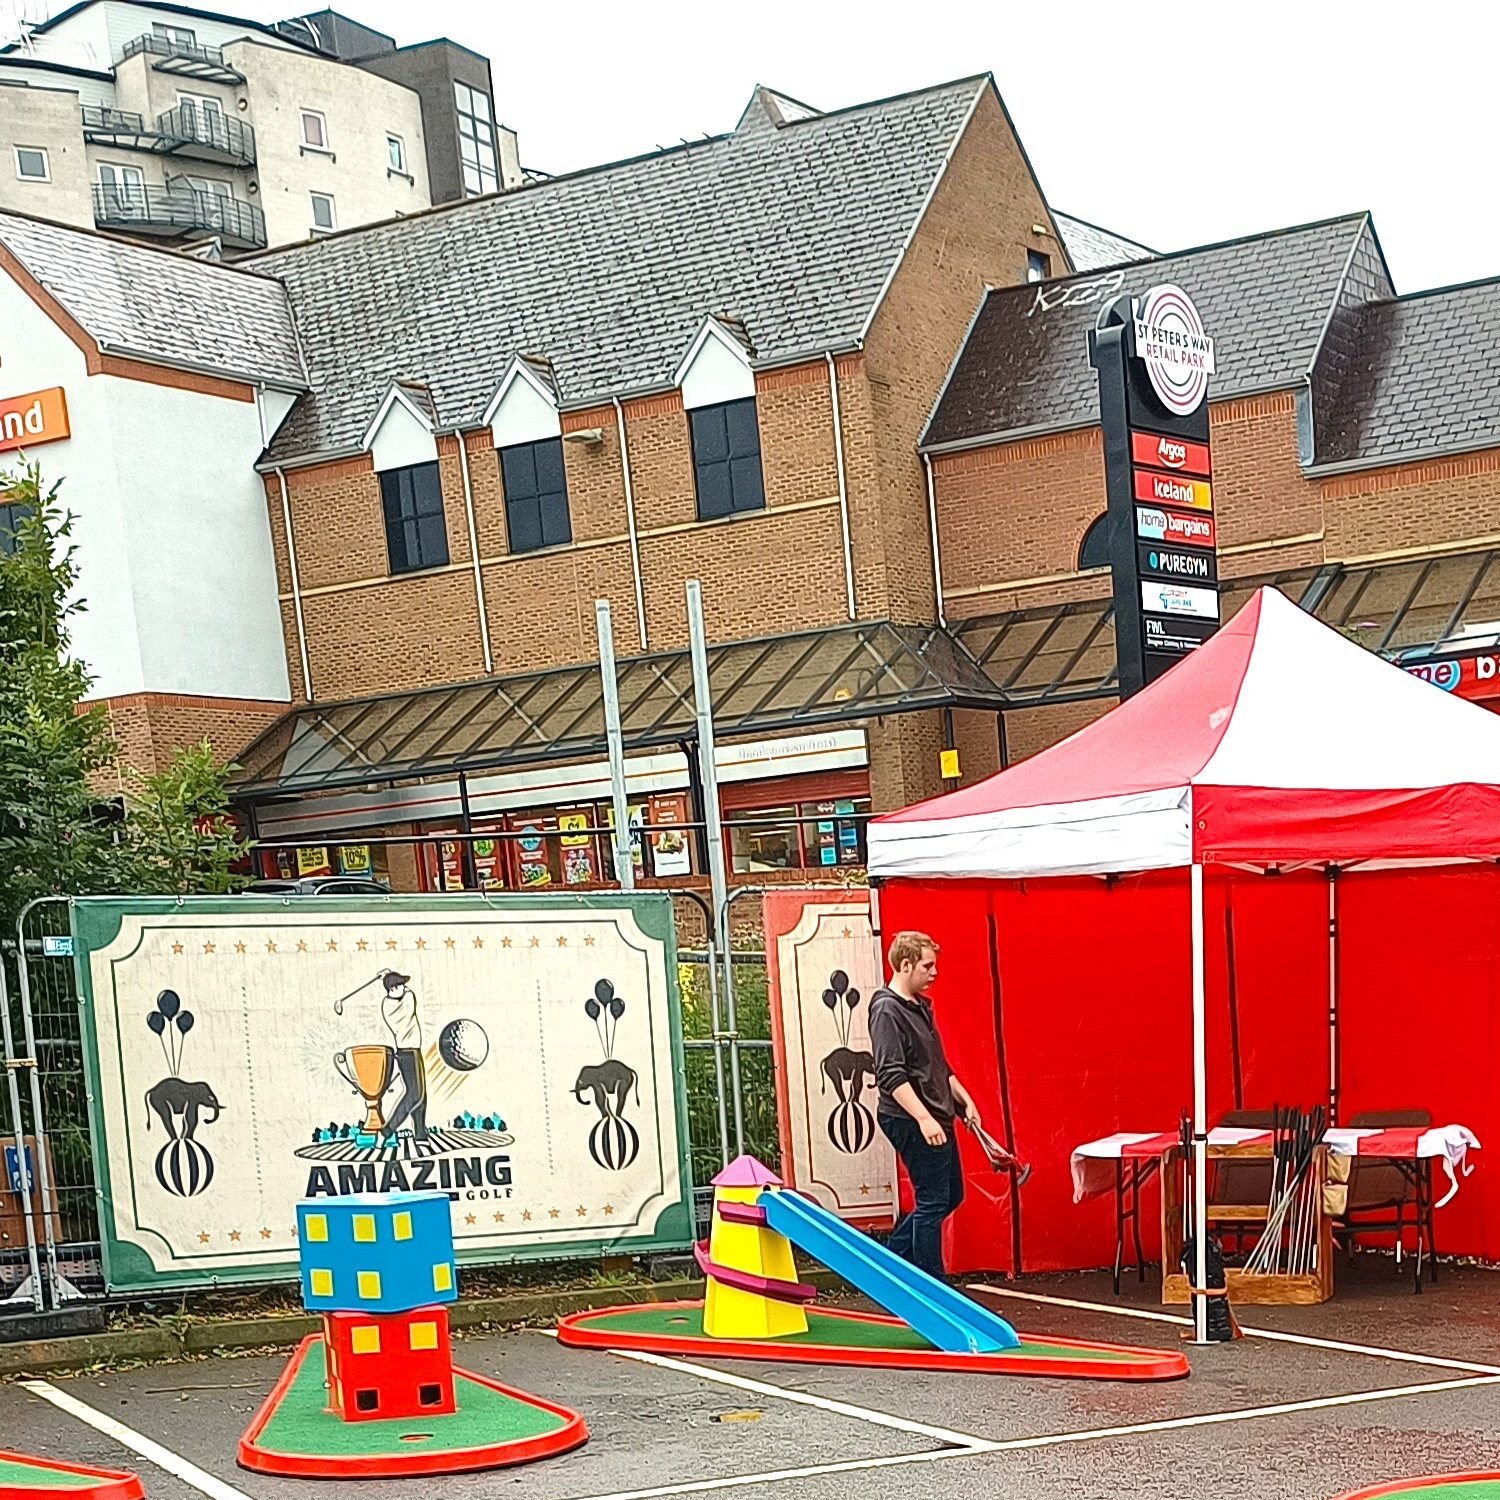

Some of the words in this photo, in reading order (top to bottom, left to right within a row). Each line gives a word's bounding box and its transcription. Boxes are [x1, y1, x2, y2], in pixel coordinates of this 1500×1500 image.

[1138, 323, 1149, 340] ST
[1190, 335, 1210, 353] WAY
[1146, 342, 1179, 363] RETAIL
[1181, 350, 1206, 369] PARK
[1157, 437, 1186, 461] Argos
[1153, 476, 1194, 503] Iceland
[1166, 512, 1210, 537] bargains
[1407, 664, 1452, 685] me
[305, 1155, 513, 1198] AMAZING
[466, 1188, 514, 1201] GOLF
